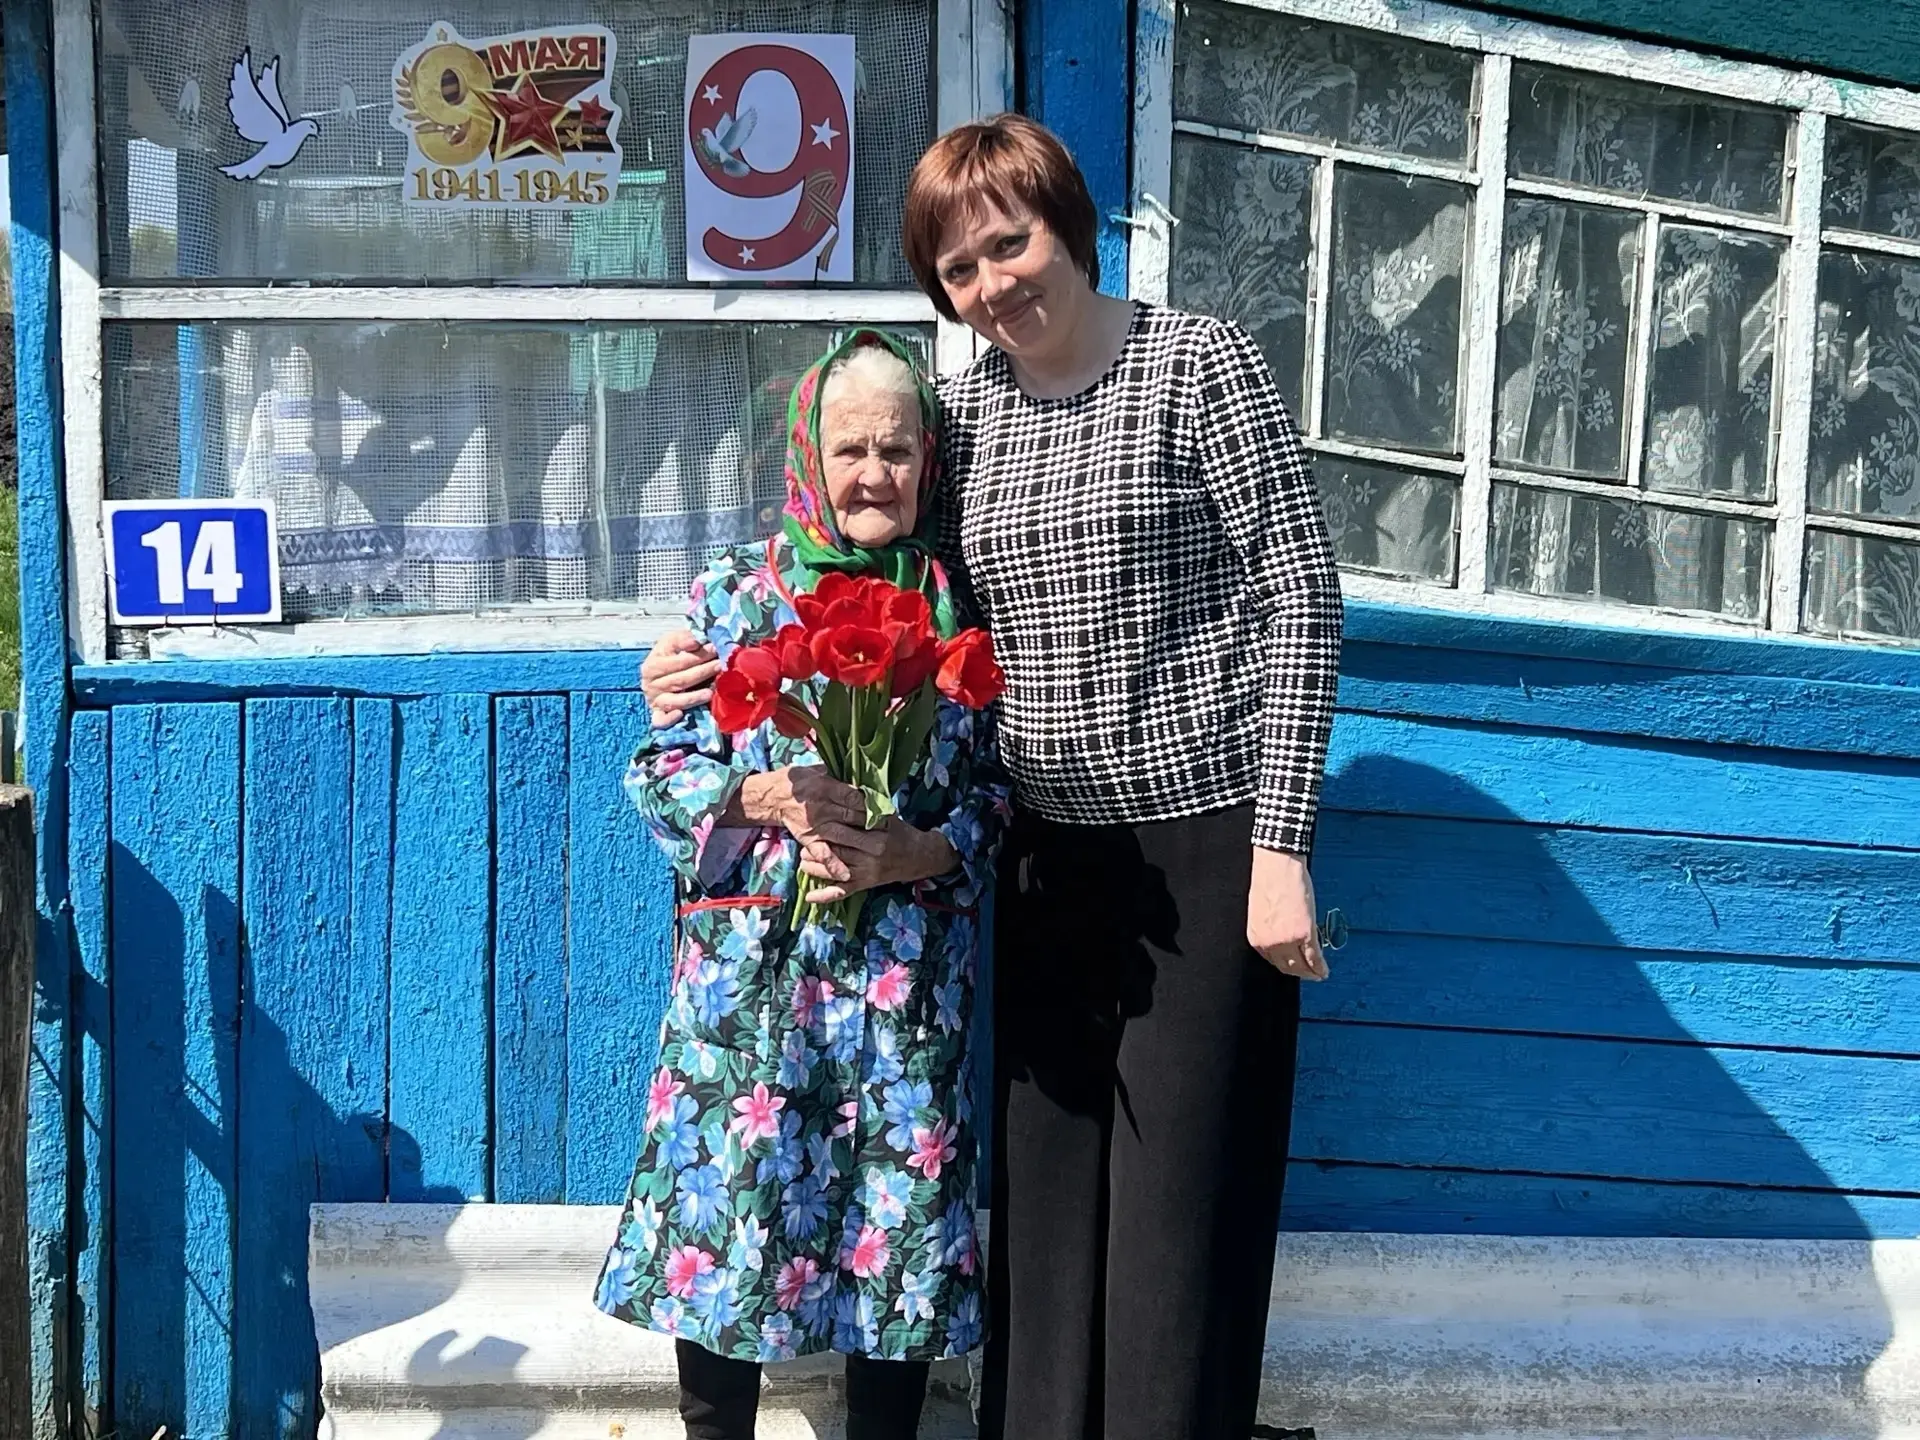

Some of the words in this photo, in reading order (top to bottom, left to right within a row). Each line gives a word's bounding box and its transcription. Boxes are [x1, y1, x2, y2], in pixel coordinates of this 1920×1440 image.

[411, 43, 494, 166] 9
[489, 36, 602, 78] МАЯ
[411, 167, 609, 204] 1941-1945
[689, 44, 850, 271] 9
[141, 520, 244, 605] 14
